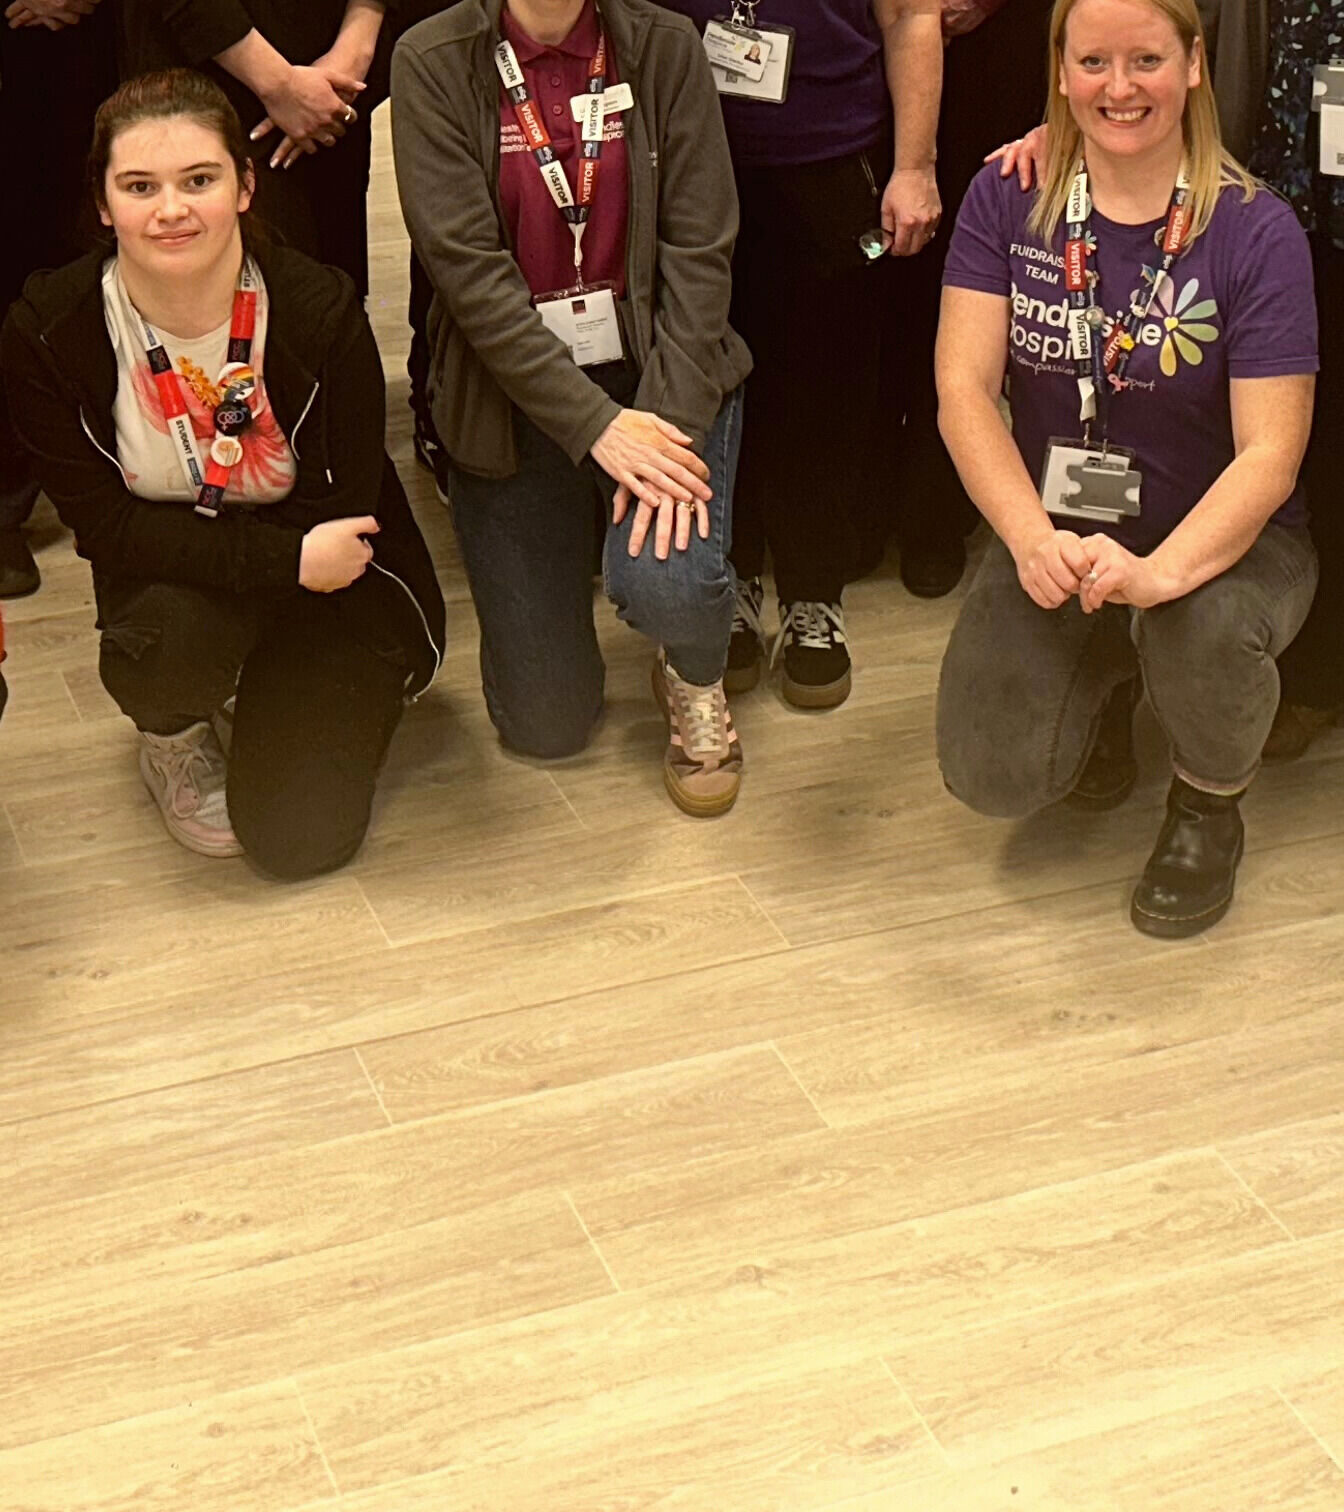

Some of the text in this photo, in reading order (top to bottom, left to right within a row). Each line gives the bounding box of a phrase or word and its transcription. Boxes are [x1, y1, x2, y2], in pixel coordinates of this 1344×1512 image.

[497, 45, 518, 82] VISITOR
[521, 104, 544, 143] VISITOR
[588, 98, 599, 136] VISITOR
[548, 167, 569, 205] VISITOR
[582, 162, 594, 202] VISITOR
[1025, 265, 1060, 285] TEAM
[1071, 243, 1081, 285] VISITOR
[1011, 320, 1072, 363] ospi
[1077, 315, 1089, 356] VISITOR
[176, 419, 193, 455] STUDENT
